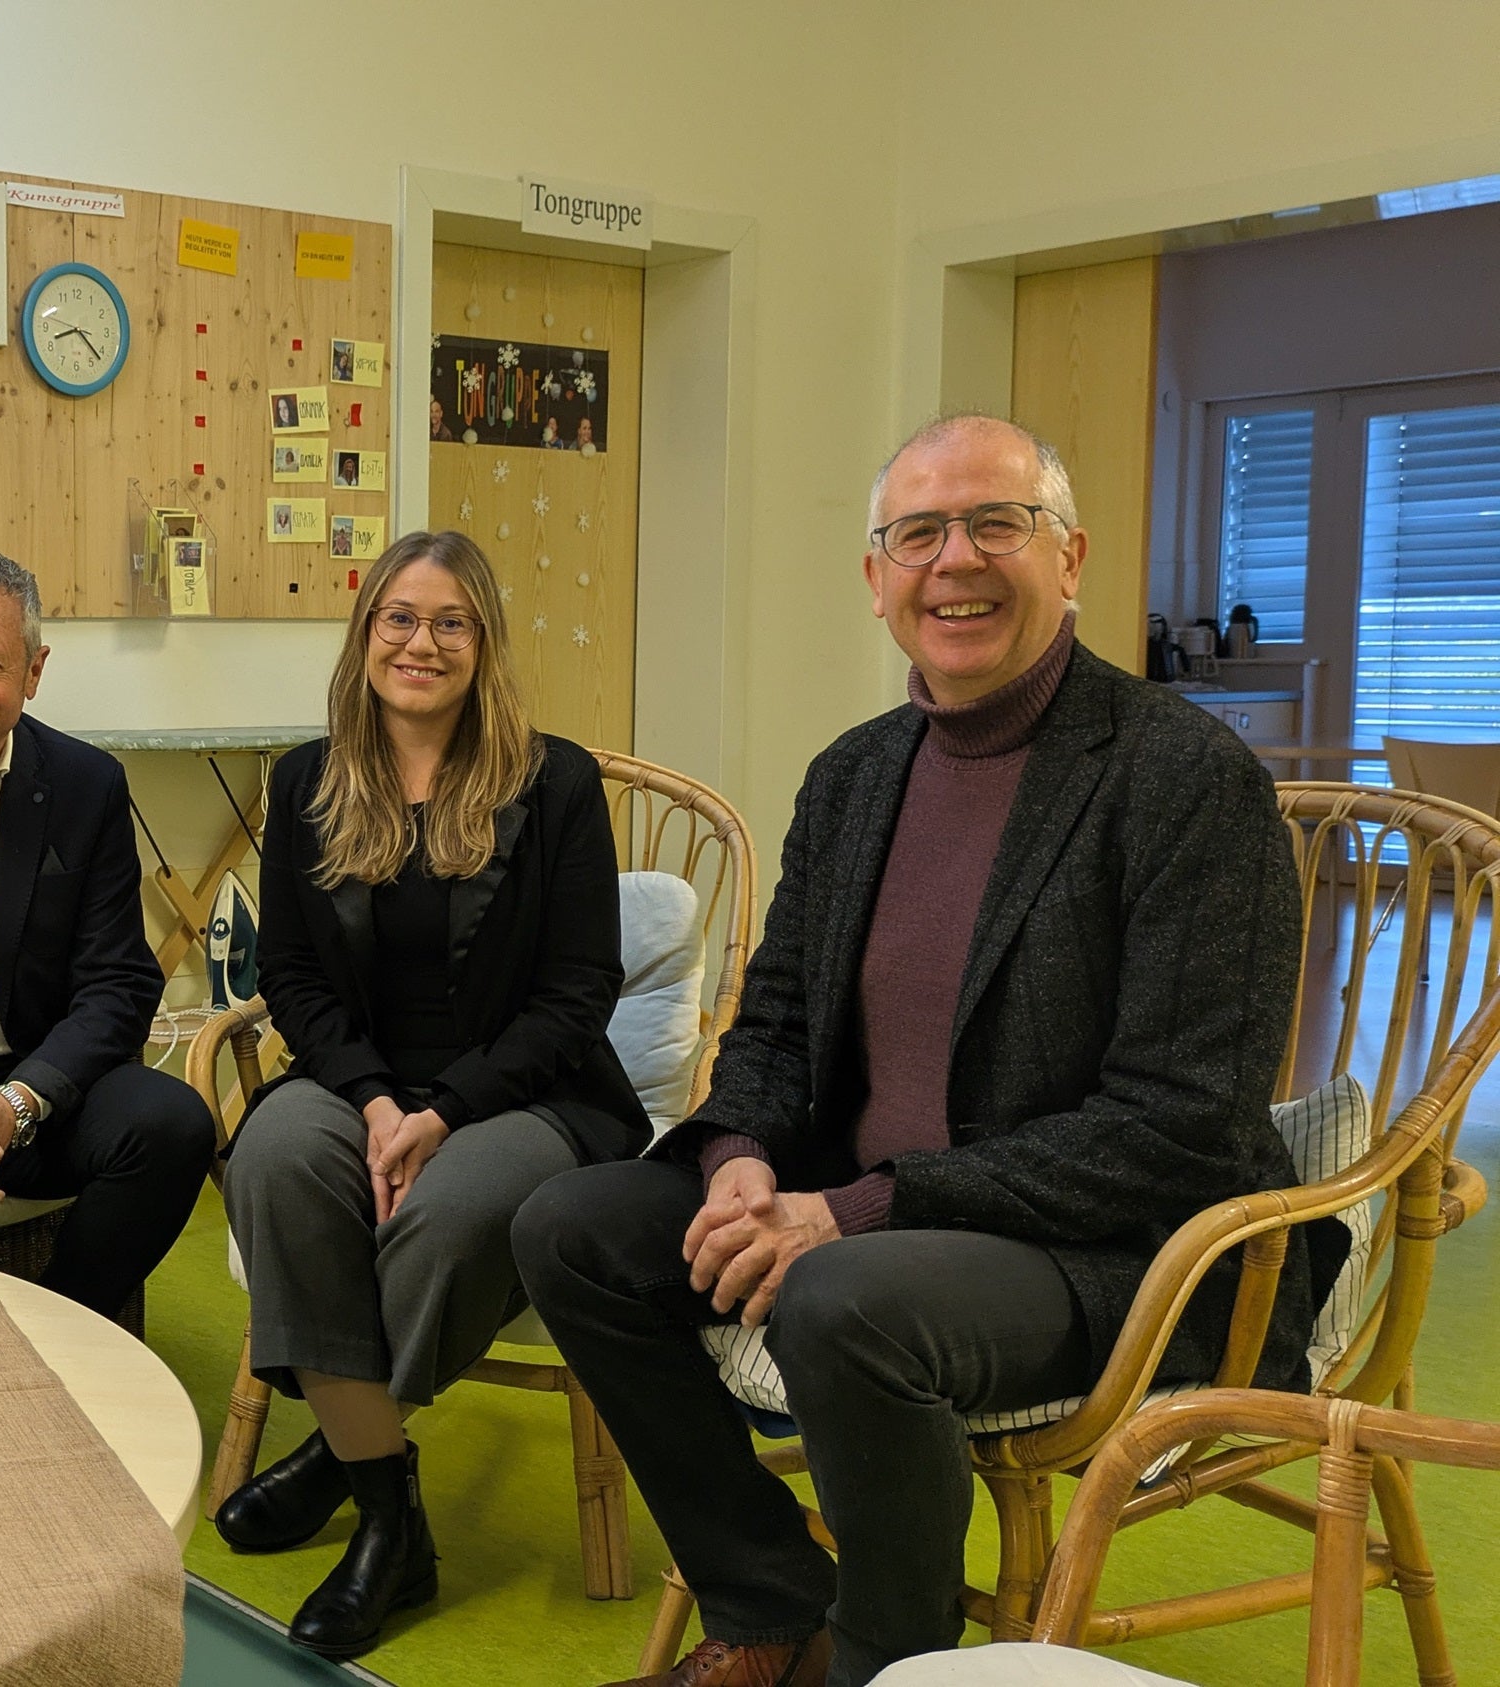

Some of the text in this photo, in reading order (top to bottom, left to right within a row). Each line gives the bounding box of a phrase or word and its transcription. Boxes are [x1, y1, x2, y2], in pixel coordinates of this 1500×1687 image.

[7, 189, 121, 211] Kunstgruppe
[530, 183, 642, 232] Tongruppe
[185, 242, 232, 259] BEGLEITET VON
[59, 293, 67, 303] 11
[72, 288, 82, 300] 12
[99, 308, 105, 319] 2
[42, 321, 49, 333] 9
[104, 327, 110, 338] 3
[47, 341, 54, 352] 8
[99, 345, 105, 356] 4
[59, 355, 66, 367] 7
[73, 360, 80, 372] 6
[88, 357, 94, 368] 5
[361, 460, 384, 479] EDITH
